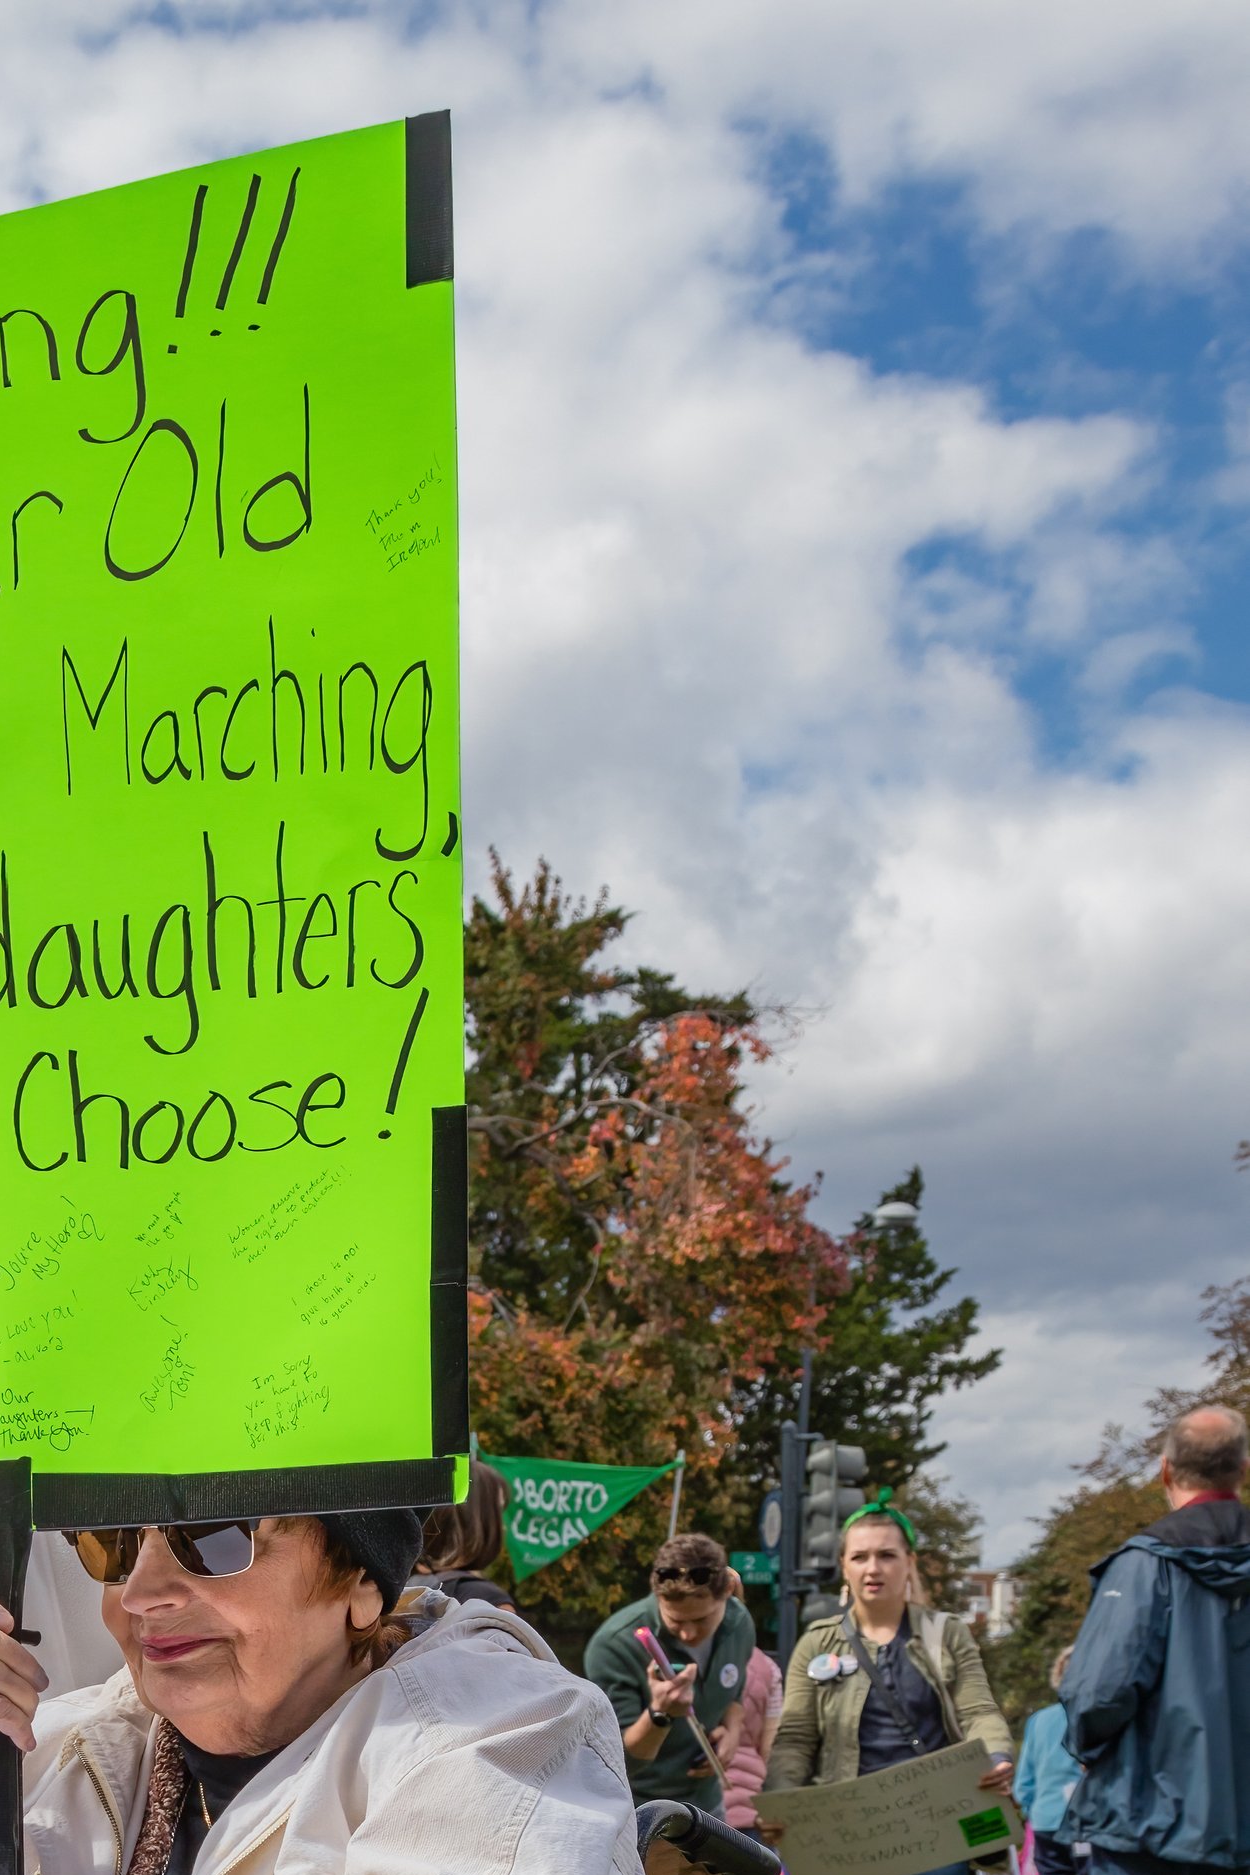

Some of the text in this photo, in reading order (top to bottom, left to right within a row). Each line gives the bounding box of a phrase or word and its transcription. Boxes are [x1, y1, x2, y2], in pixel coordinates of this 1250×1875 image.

[104, 383, 313, 581] Old
[365, 500, 402, 534] Thank
[14, 988, 429, 1173] Choose!
[32, 1257, 60, 1280] My
[1, 1388, 34, 1405] Our
